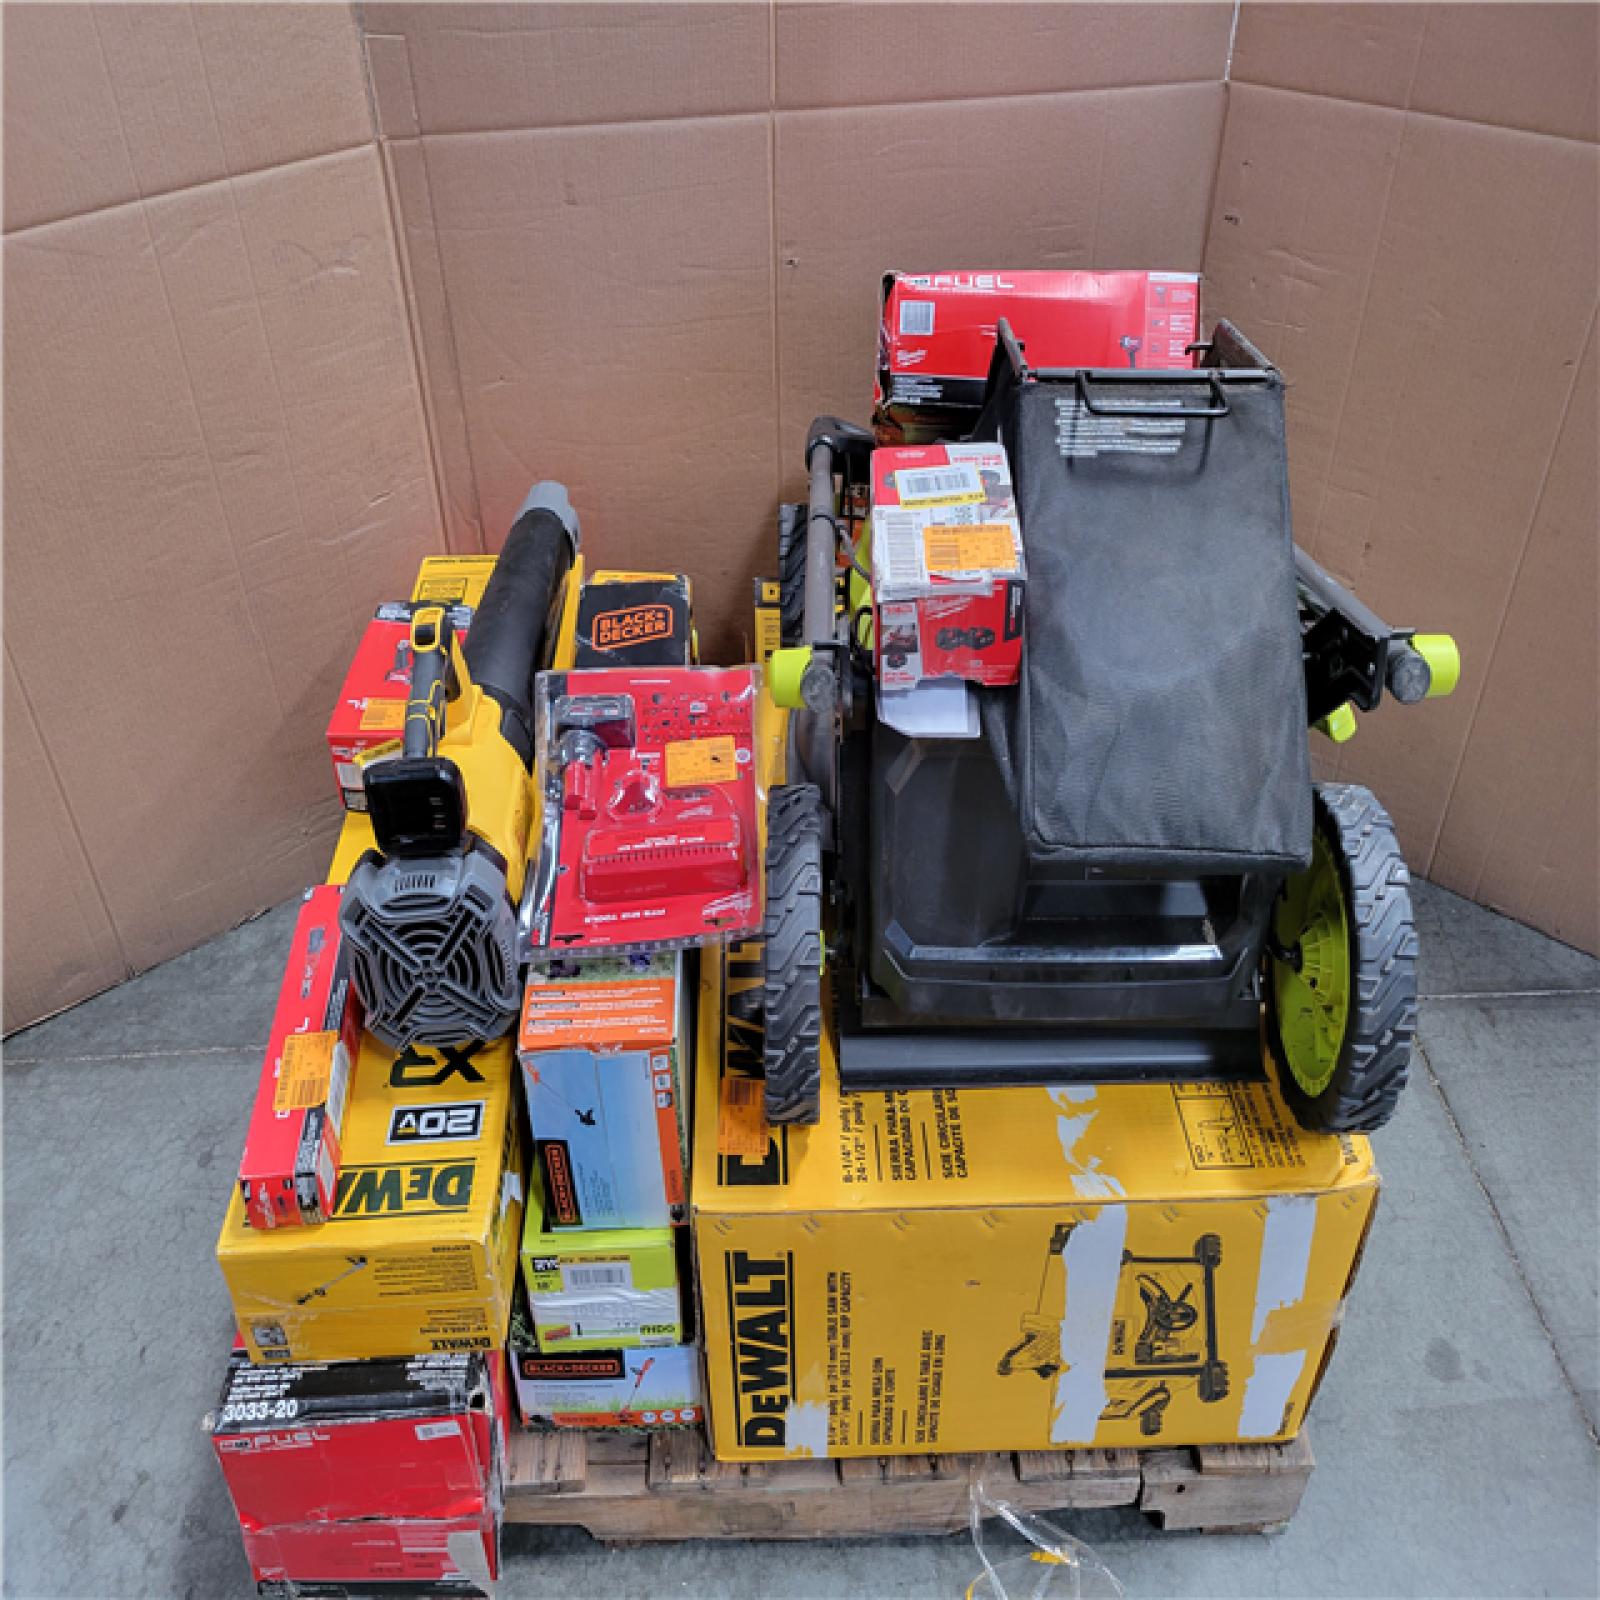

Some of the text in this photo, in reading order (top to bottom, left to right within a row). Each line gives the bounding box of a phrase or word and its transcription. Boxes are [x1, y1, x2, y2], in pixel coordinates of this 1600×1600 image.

[933, 274, 1014, 289] FUEL
[600, 620, 666, 643] DECKER
[885, 1106, 898, 1135] PARA
[888, 1138, 902, 1181] SIERRA
[900, 1117, 916, 1181] CAPACIDAD
[940, 1152, 953, 1179] SCIE
[733, 1251, 787, 1447] DEWALT
[223, 1399, 298, 1421] 3033-20
[254, 1430, 331, 1452] FUEL
